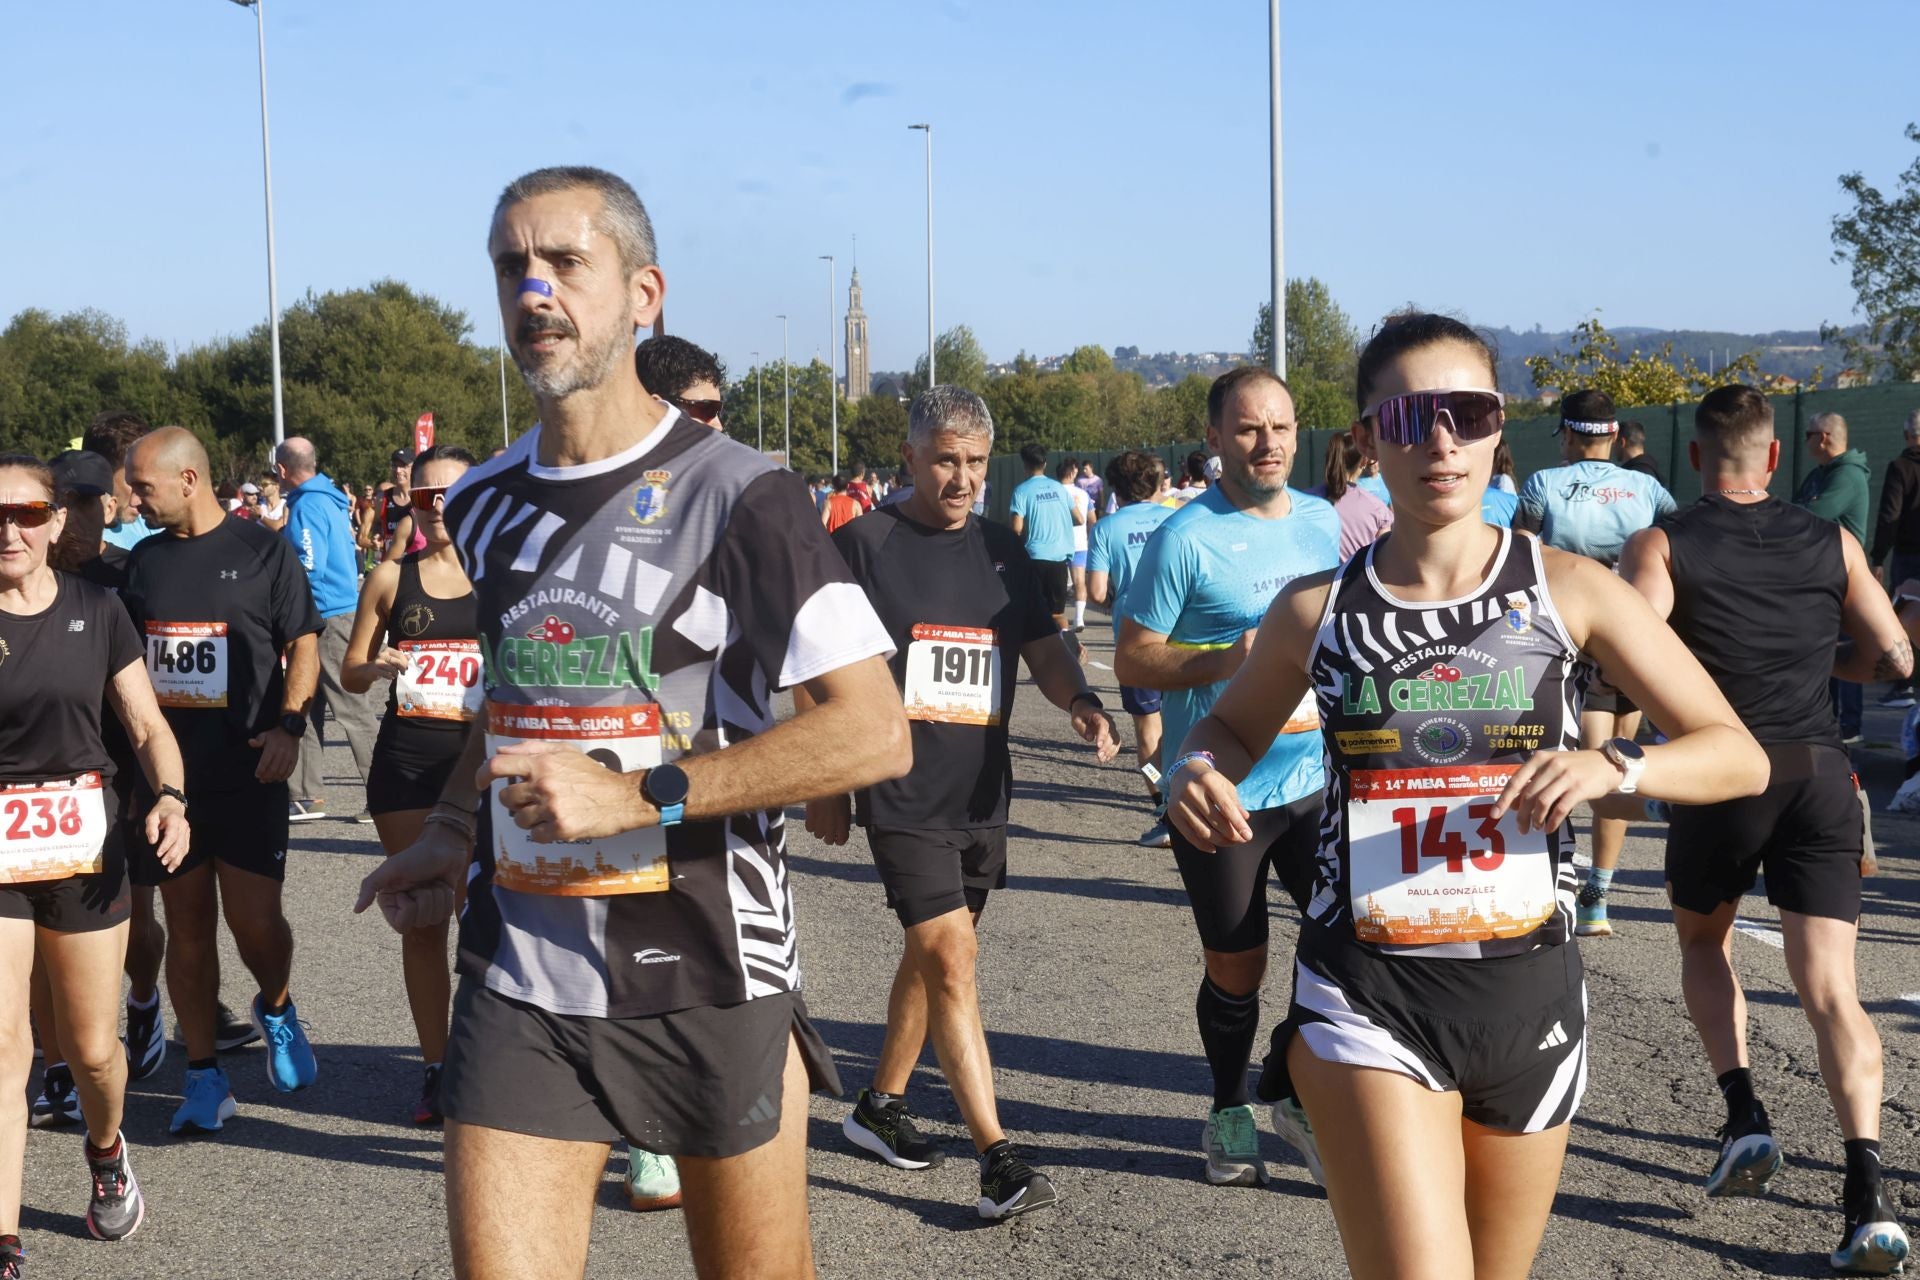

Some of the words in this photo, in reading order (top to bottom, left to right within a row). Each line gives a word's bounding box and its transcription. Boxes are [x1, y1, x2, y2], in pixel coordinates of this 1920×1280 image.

[500, 588, 620, 628] RESTAURANTE
[153, 640, 216, 674] 1486
[416, 655, 479, 688] 240
[498, 626, 660, 691] CEREZAL
[931, 645, 992, 687] 1911
[1391, 644, 1498, 675] RESTAURANTE
[1342, 672, 1382, 715] LA
[1388, 666, 1534, 712] CEREZAL
[516, 718, 550, 730] MBA
[580, 716, 624, 731] GIJÓN
[1483, 724, 1545, 736] DEPORTES
[1489, 738, 1539, 750] SOBRINO
[1385, 779, 1405, 791] 14ª
[1407, 777, 1447, 790] MBA
[1448, 775, 1470, 783] media
[1448, 781, 1479, 789] maratón
[4, 795, 83, 841] 238
[1392, 803, 1506, 874] 143
[1407, 887, 1440, 897] PAULA
[1442, 885, 1496, 896] GONZÁLEZ
